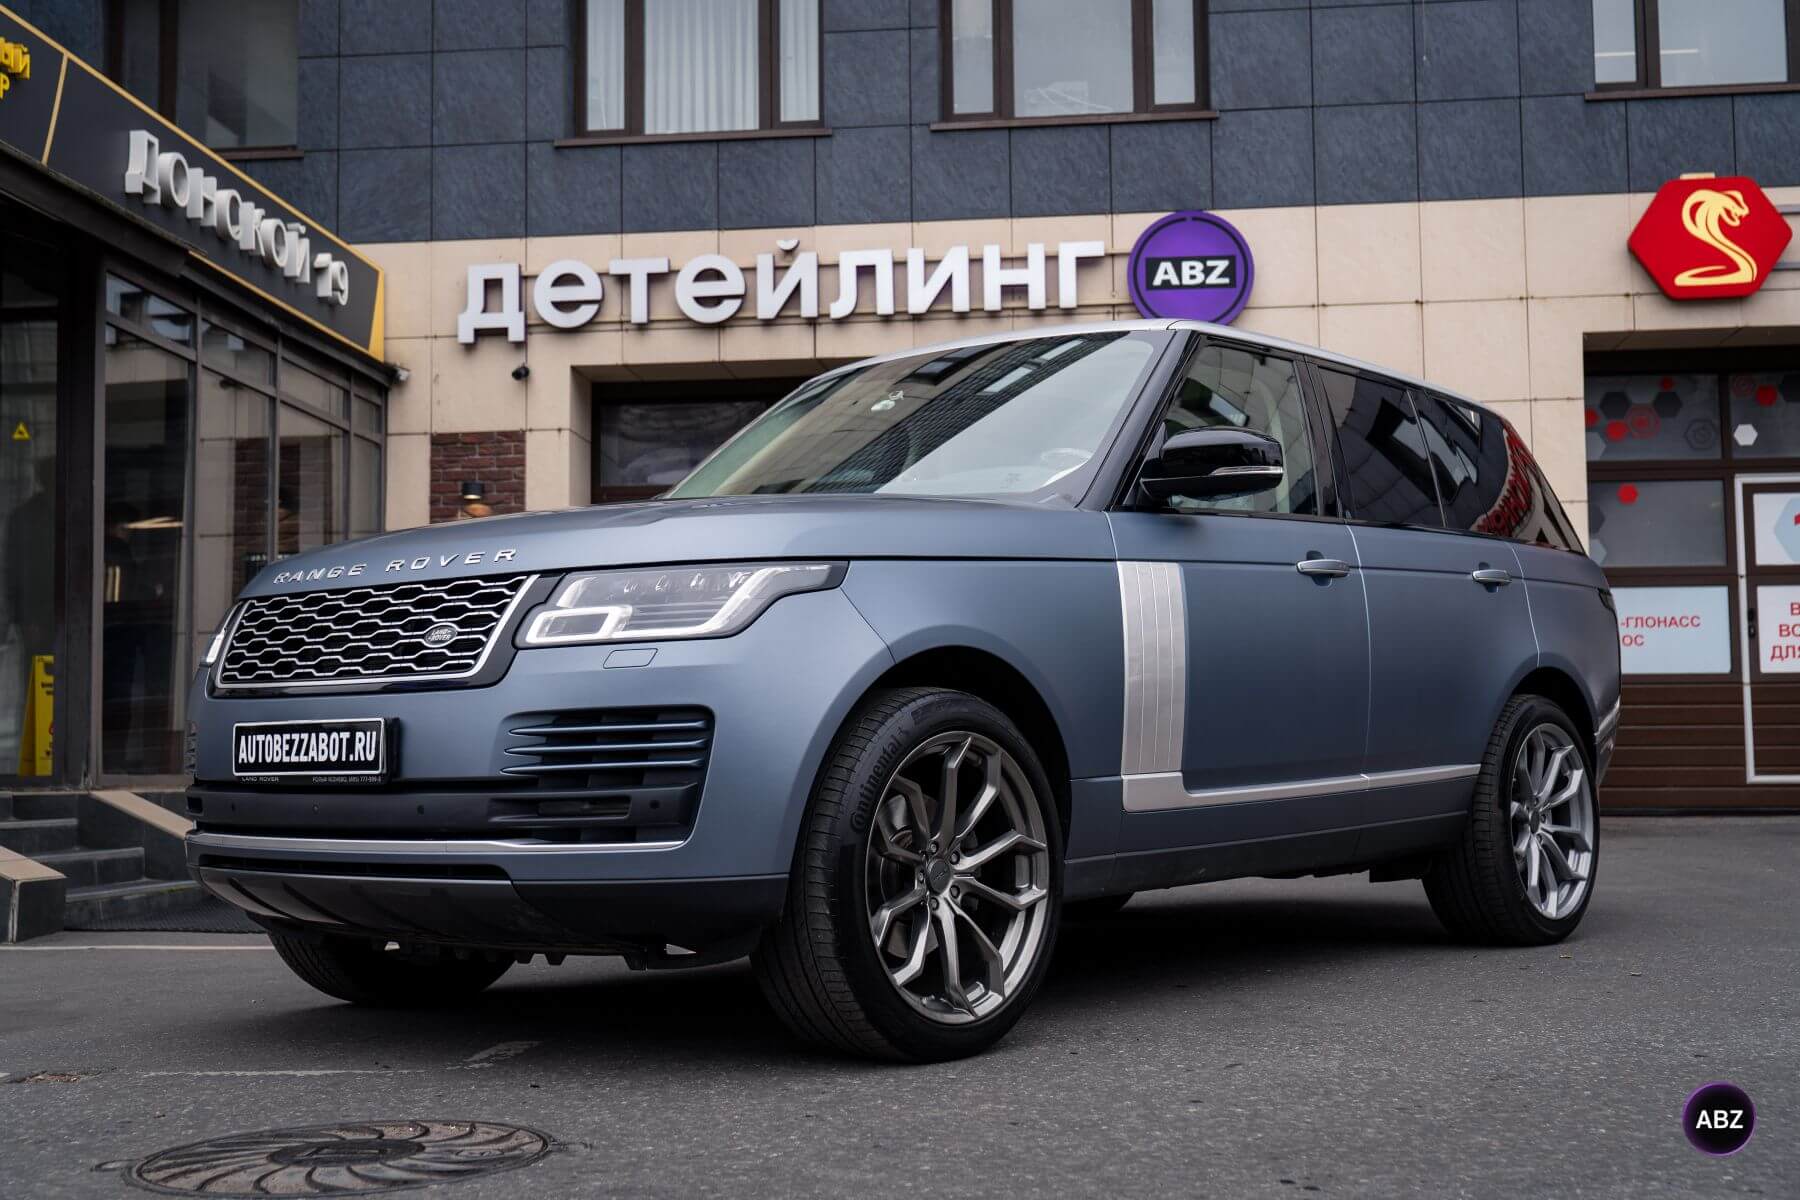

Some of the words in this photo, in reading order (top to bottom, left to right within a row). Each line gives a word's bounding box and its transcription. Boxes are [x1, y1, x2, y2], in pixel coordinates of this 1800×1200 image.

[125, 129, 311, 284] Донской
[314, 253, 349, 306] 19
[1152, 259, 1230, 286] ABZ
[457, 239, 1105, 345] детейлинг
[273, 563, 367, 584] RANGE
[385, 548, 517, 572] ROVER
[1770, 645, 1800, 661] ДЛ
[238, 731, 377, 763] AUTOBEZZABOT.RU
[850, 734, 904, 833] Continental
